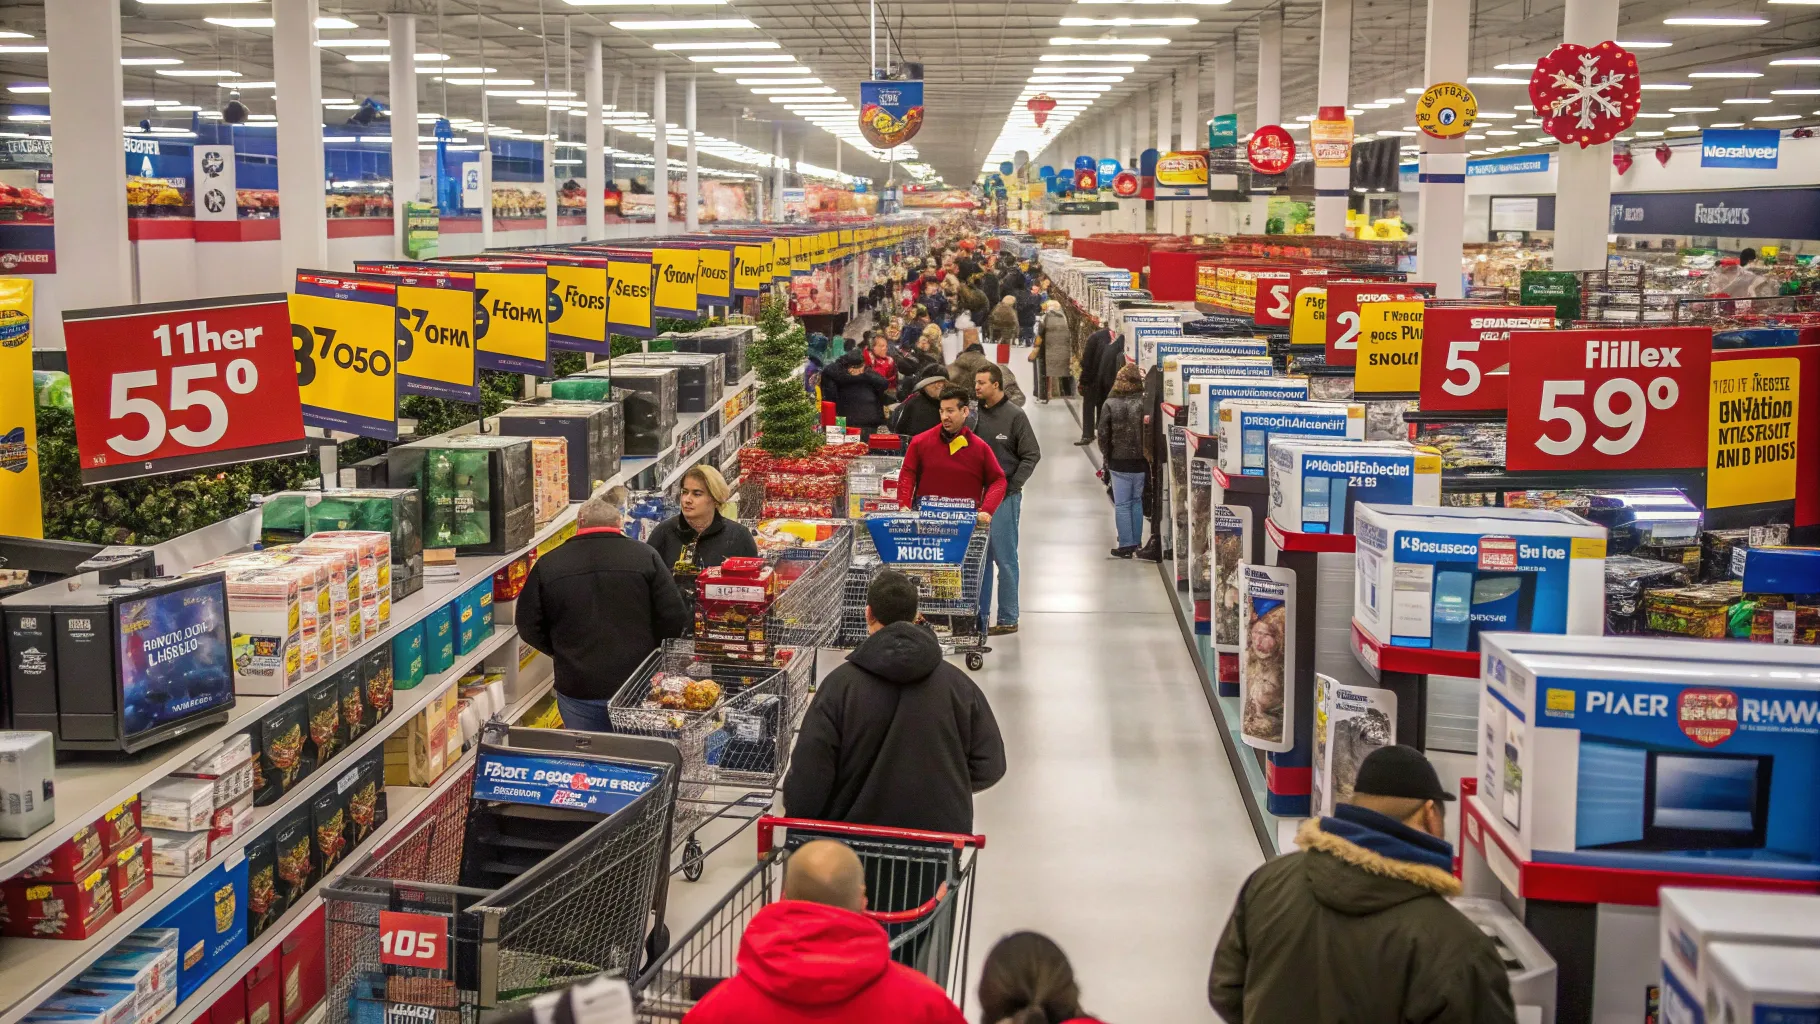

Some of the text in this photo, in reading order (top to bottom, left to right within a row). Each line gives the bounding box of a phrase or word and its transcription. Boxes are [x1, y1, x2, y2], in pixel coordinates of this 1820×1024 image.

[1586, 340, 1682, 368] Flillex
[1441, 341, 1481, 397] 5
[380, 930, 437, 959] 105
